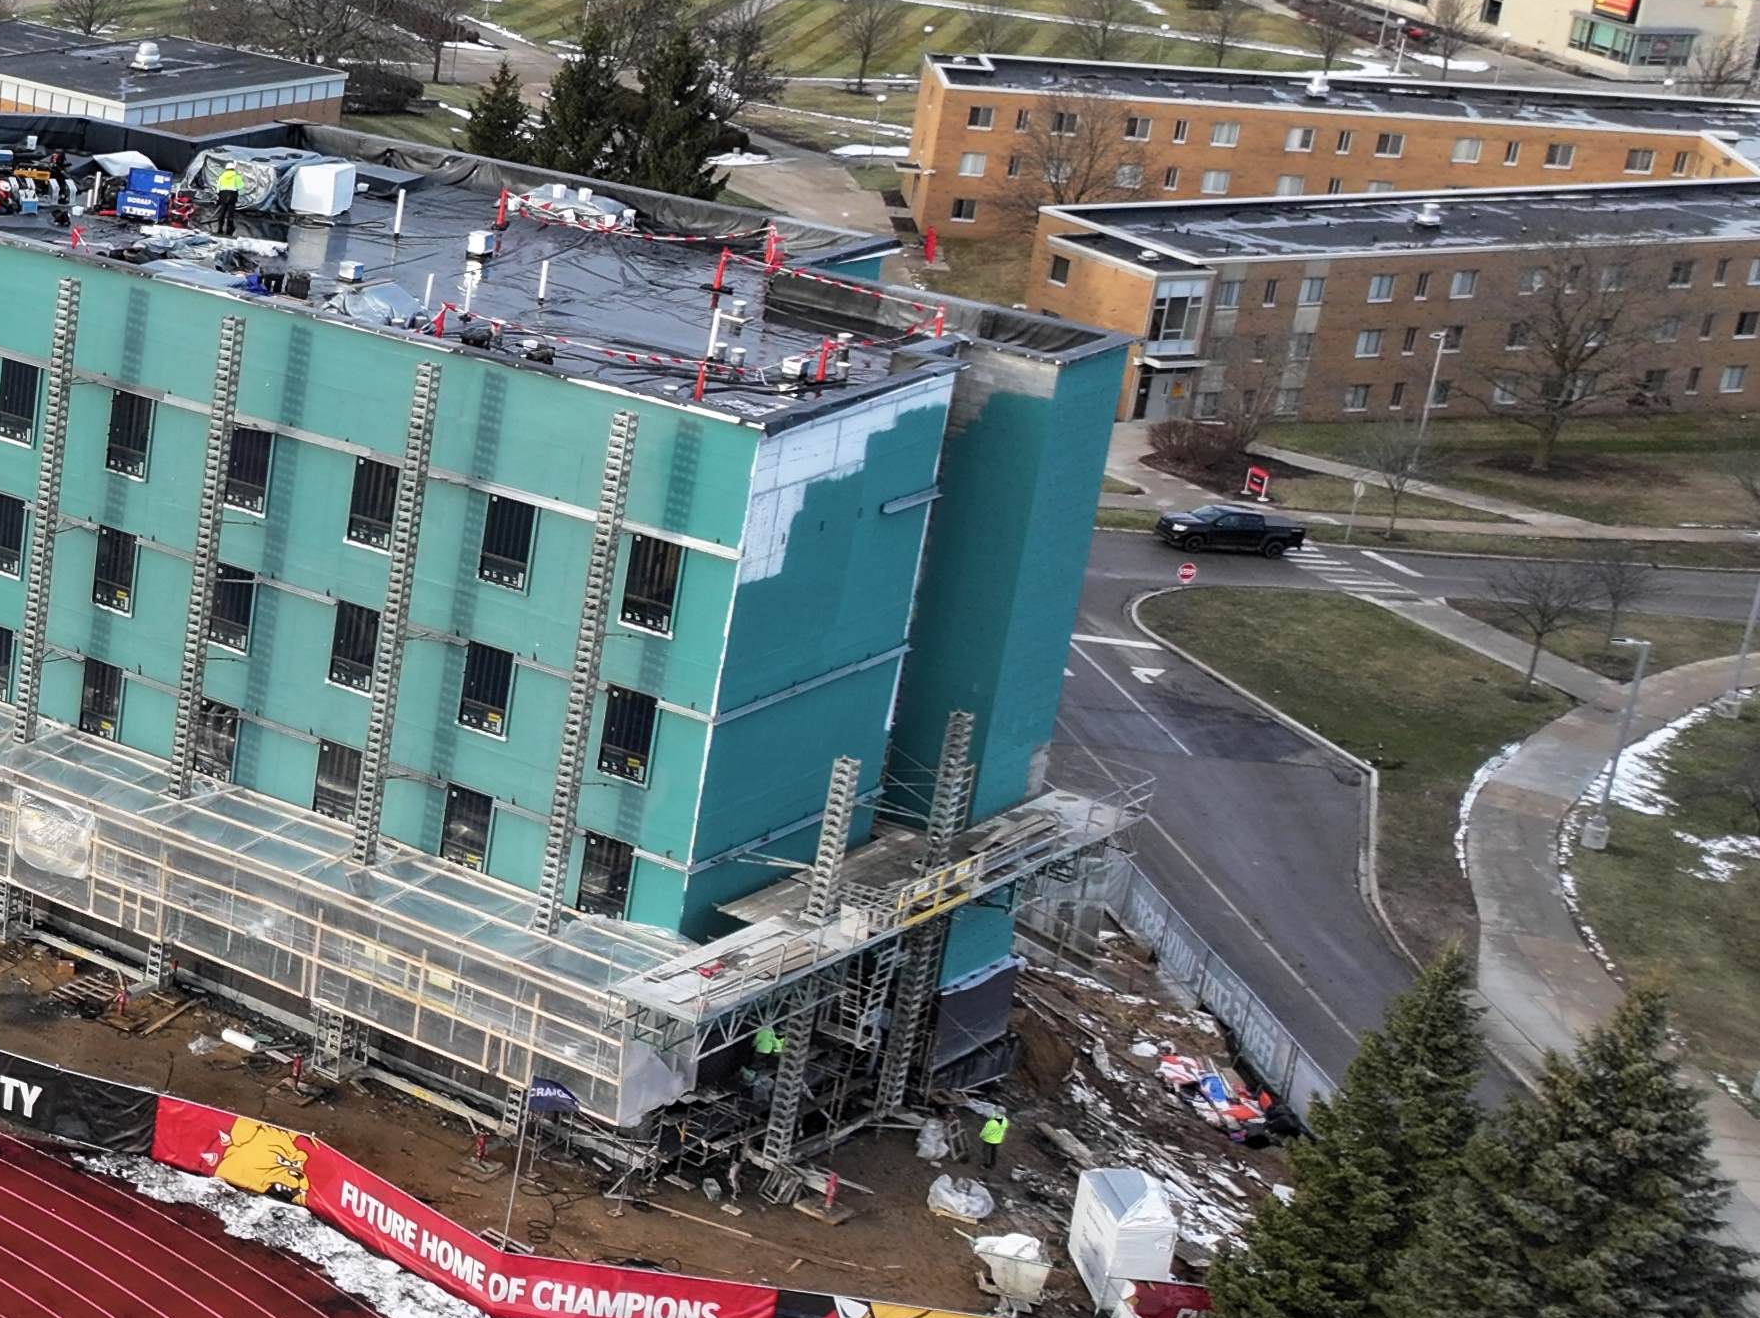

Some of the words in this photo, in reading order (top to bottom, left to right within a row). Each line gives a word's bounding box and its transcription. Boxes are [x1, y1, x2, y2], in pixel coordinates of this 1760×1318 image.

[340, 1179, 416, 1249] FUTURE
[419, 1230, 486, 1290] HOME
[488, 1273, 524, 1305] OF
